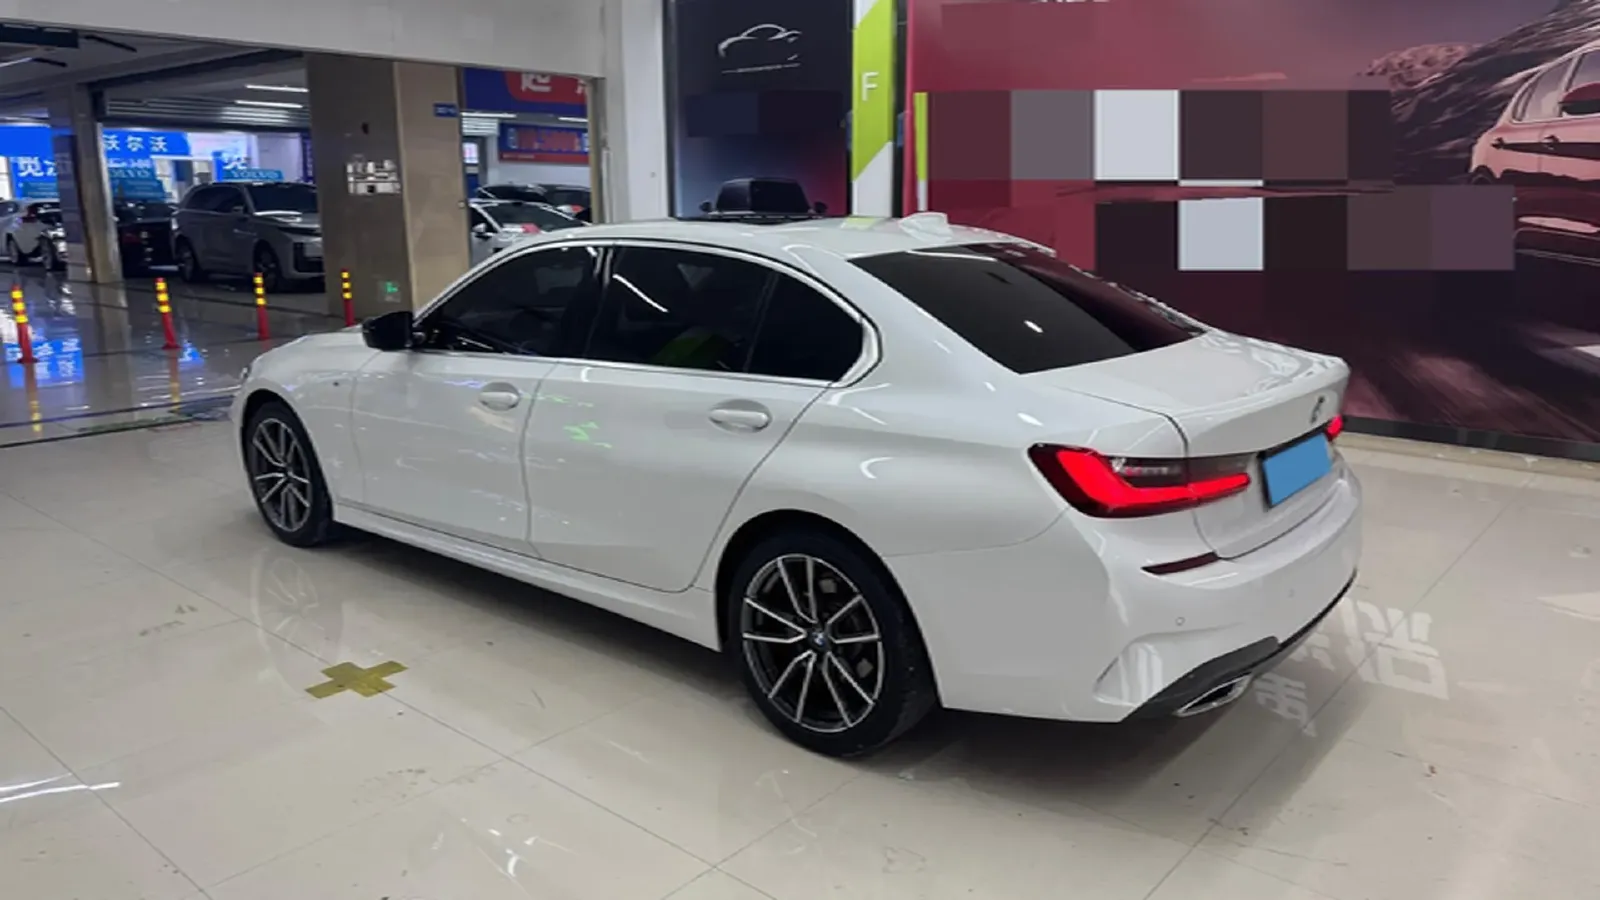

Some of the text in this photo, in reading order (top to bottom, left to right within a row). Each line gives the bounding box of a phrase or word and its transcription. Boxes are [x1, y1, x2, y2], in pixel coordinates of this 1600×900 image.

[861, 71, 879, 102] F
[102, 134, 168, 152] 沃尔沃
